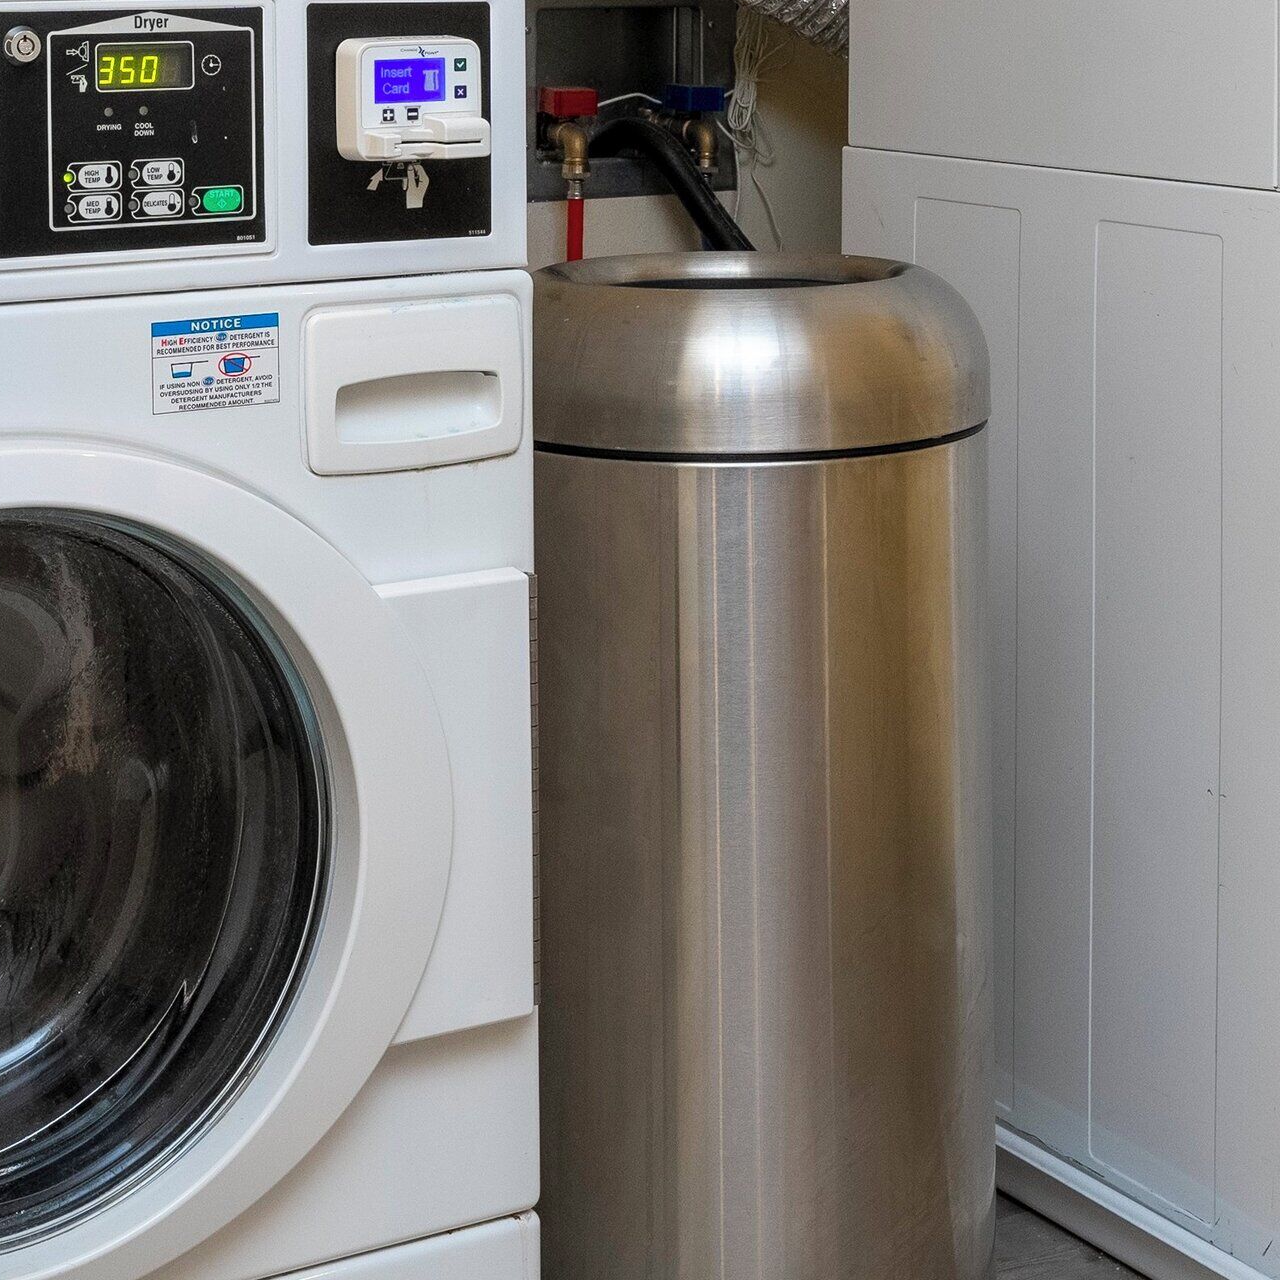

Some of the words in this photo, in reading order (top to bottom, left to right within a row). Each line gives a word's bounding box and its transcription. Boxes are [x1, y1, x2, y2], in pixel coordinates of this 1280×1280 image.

[134, 16, 169, 31] Dryer
[99, 56, 158, 84] 350
[381, 66, 412, 78] Insert
[382, 83, 409, 94] Card
[191, 318, 241, 331] NOTICE
[179, 337, 213, 345] EFFICIENCY
[230, 332, 263, 340] DETERGENT
[157, 346, 201, 355] RECOMMENDED
[232, 339, 274, 348] PERFORMANCE
[171, 395, 207, 404] DETERGENT
[179, 400, 227, 410] RECOMMENDED
